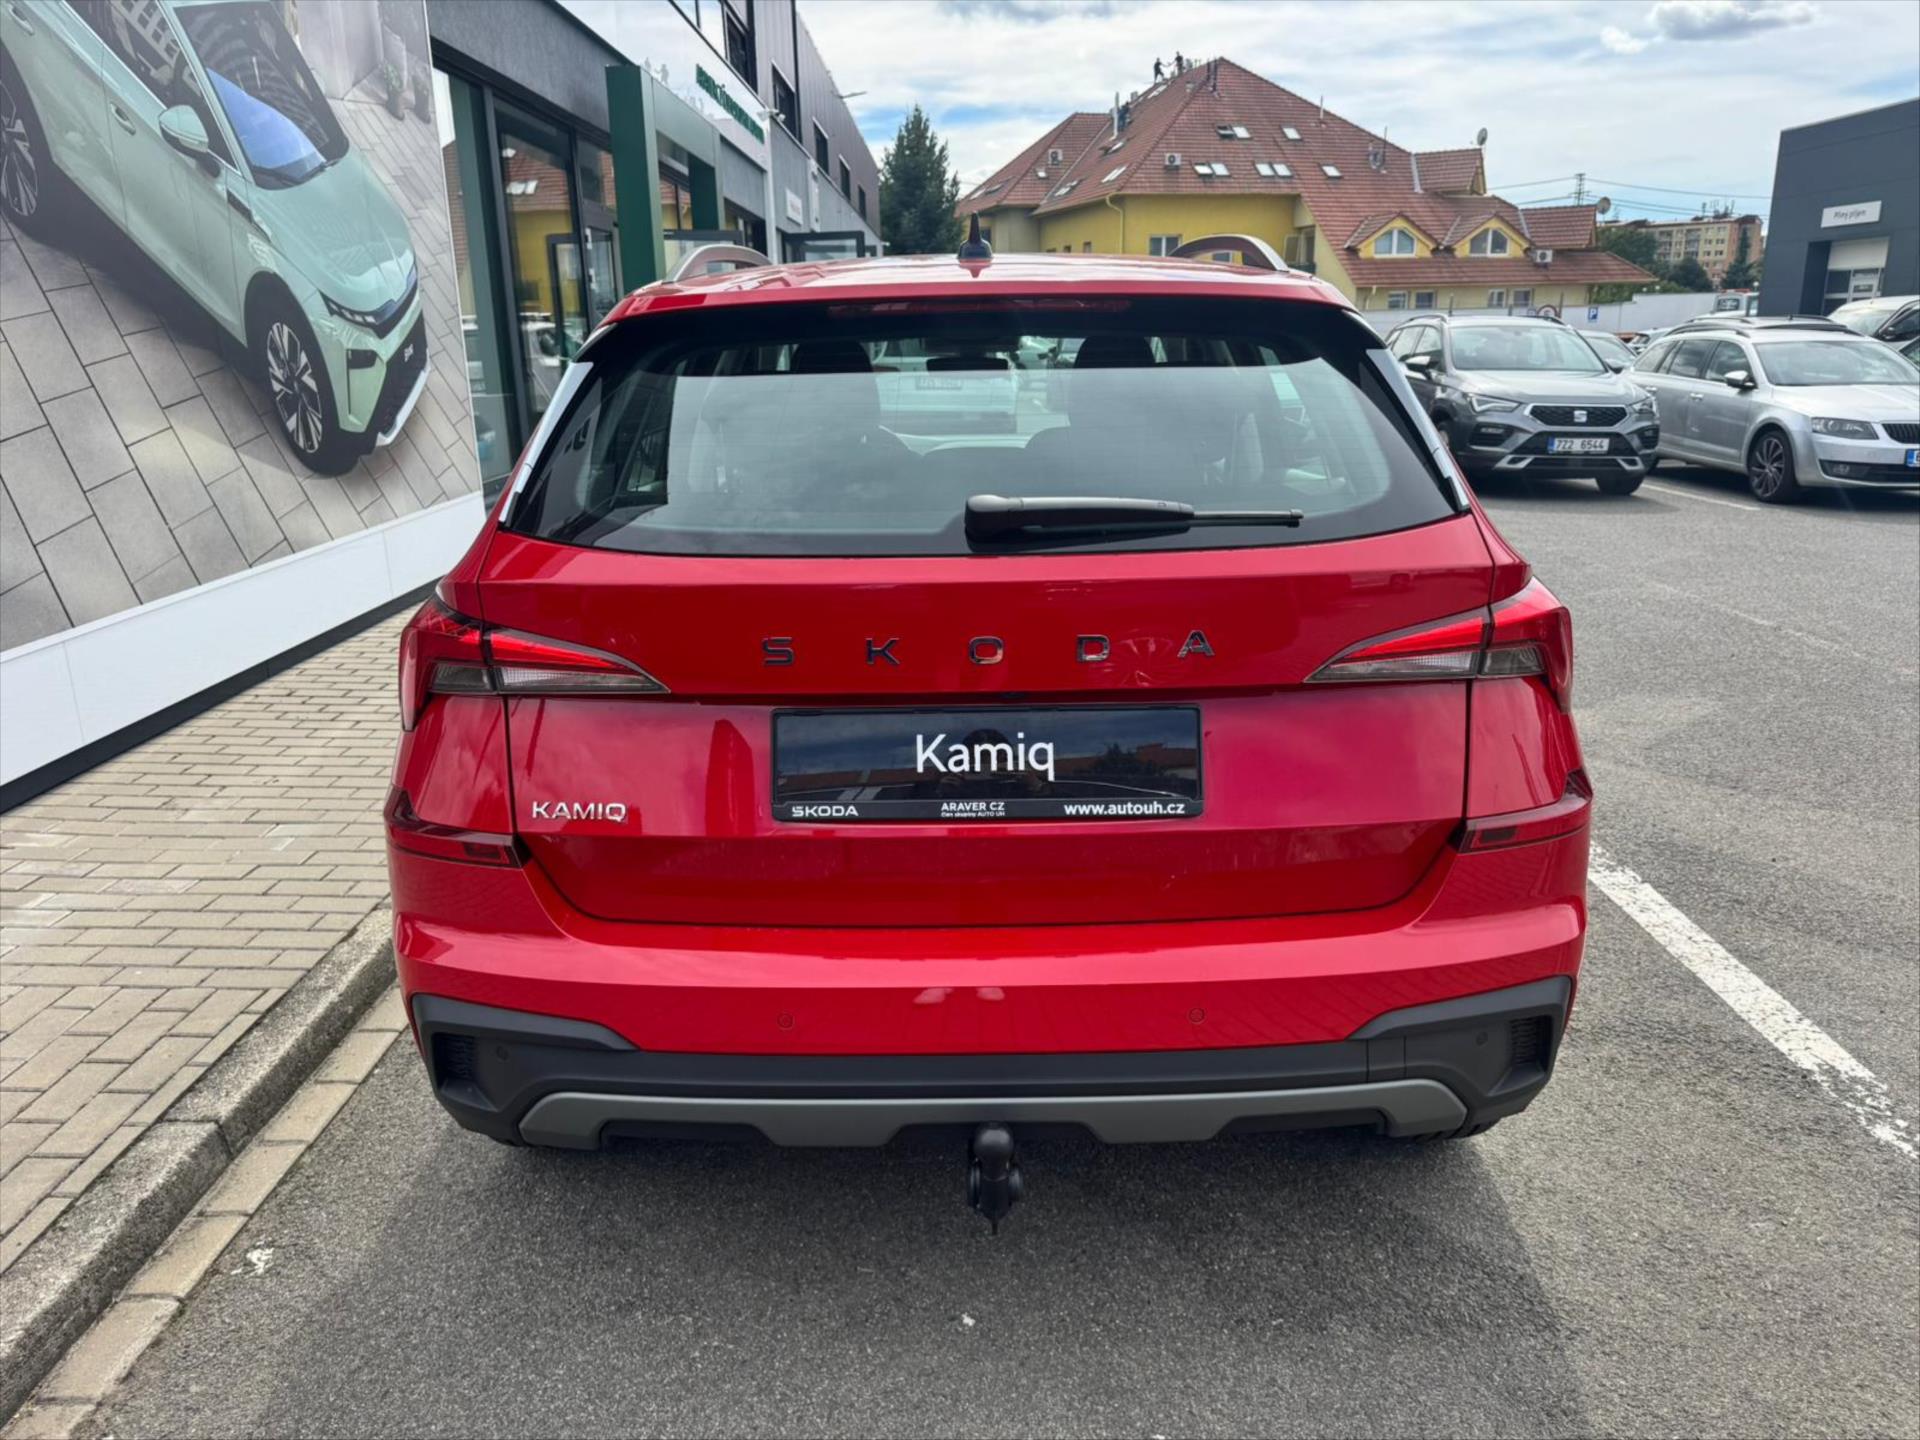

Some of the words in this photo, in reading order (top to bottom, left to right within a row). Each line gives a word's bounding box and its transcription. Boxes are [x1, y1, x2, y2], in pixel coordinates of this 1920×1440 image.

[1580, 440, 1604, 450] 6544
[762, 629, 1215, 666] SKODA
[916, 732, 1055, 782] Kamiq
[532, 801, 627, 822] KAMIQ
[940, 802, 986, 812] ARAVER
[989, 801, 1005, 811] CZ
[1063, 801, 1185, 815] www.autouh.cz
